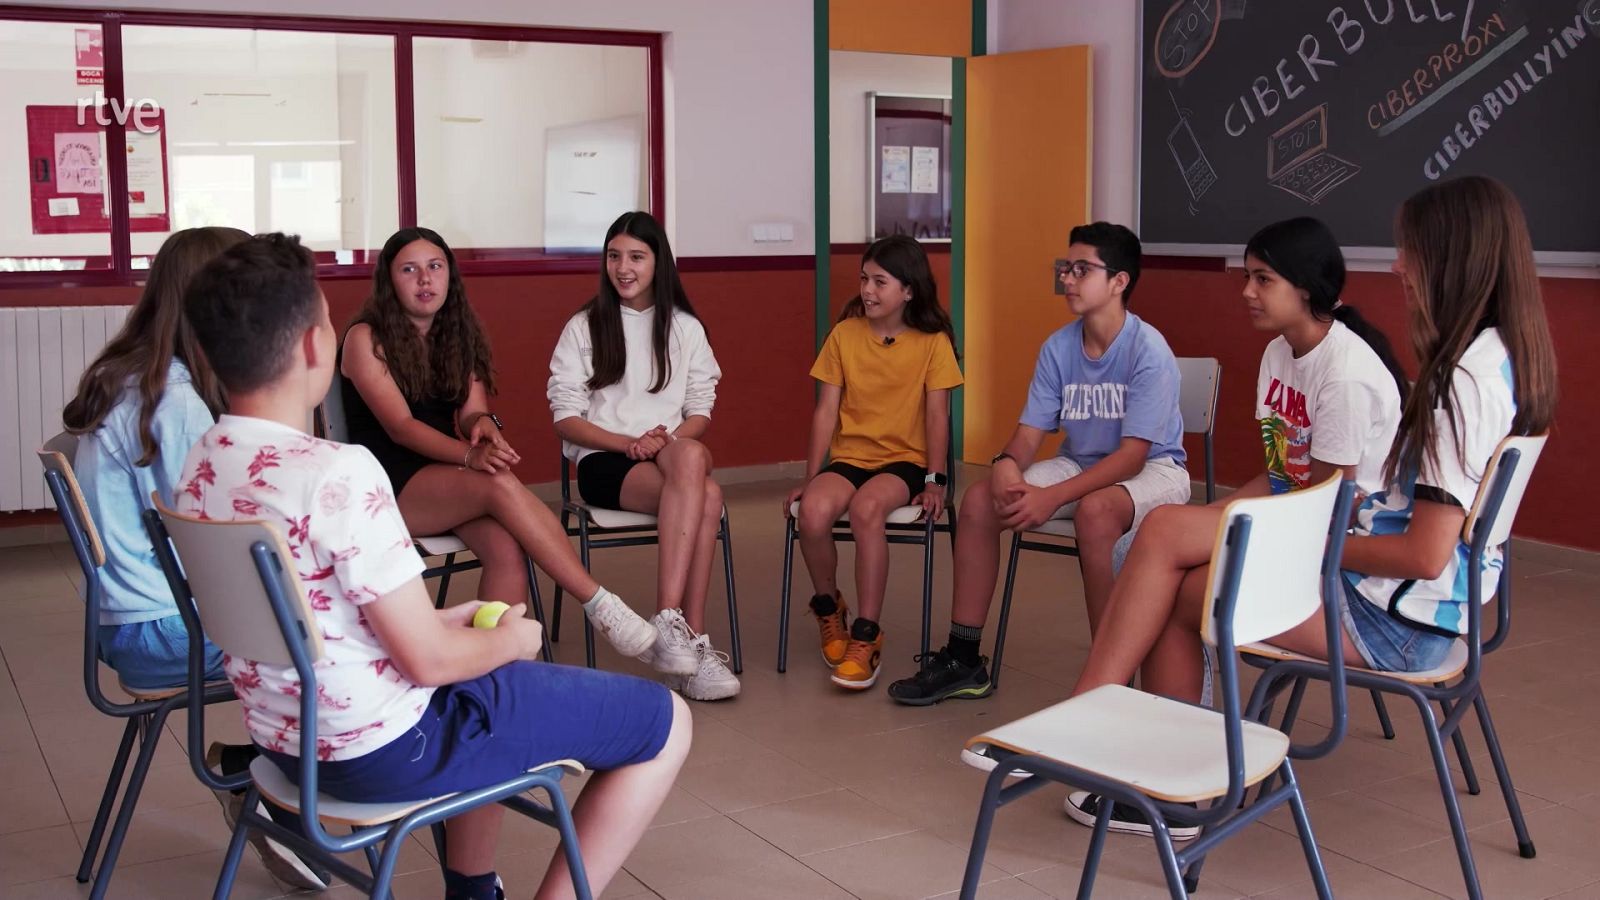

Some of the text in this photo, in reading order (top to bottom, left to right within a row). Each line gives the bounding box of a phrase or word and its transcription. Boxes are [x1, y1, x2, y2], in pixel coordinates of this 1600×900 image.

[1164, 0, 1210, 68] STOP
[1368, 13, 1506, 130] CIBERPROXY
[1278, 120, 1318, 160] STOP
